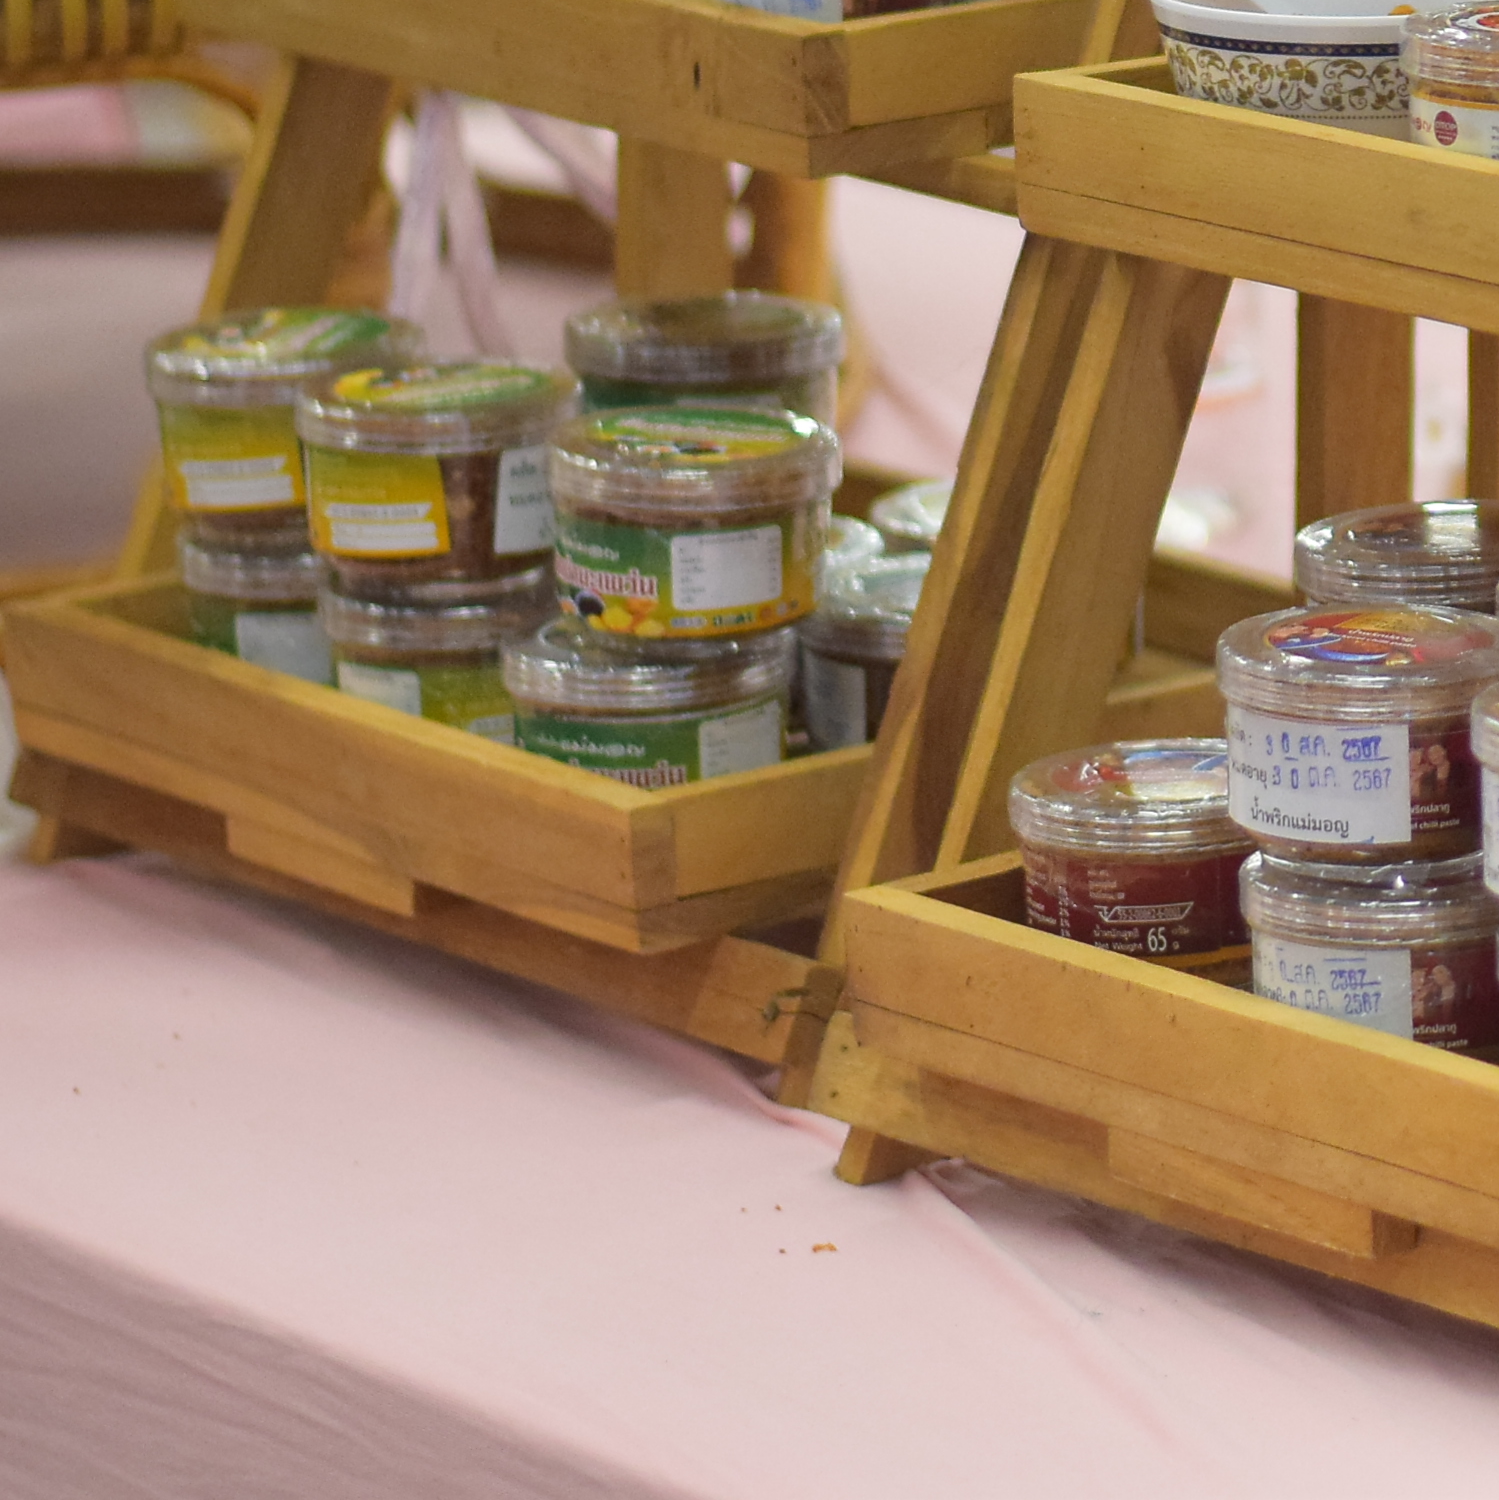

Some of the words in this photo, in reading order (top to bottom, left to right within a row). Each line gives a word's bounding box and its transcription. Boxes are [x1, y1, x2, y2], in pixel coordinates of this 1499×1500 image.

[1353, 768, 1392, 791] 2567
[1250, 797, 1349, 838] น้ำพริกแม่มอญ
[1113, 942, 1142, 952] Weight
[1148, 926, 1167, 951] 65
